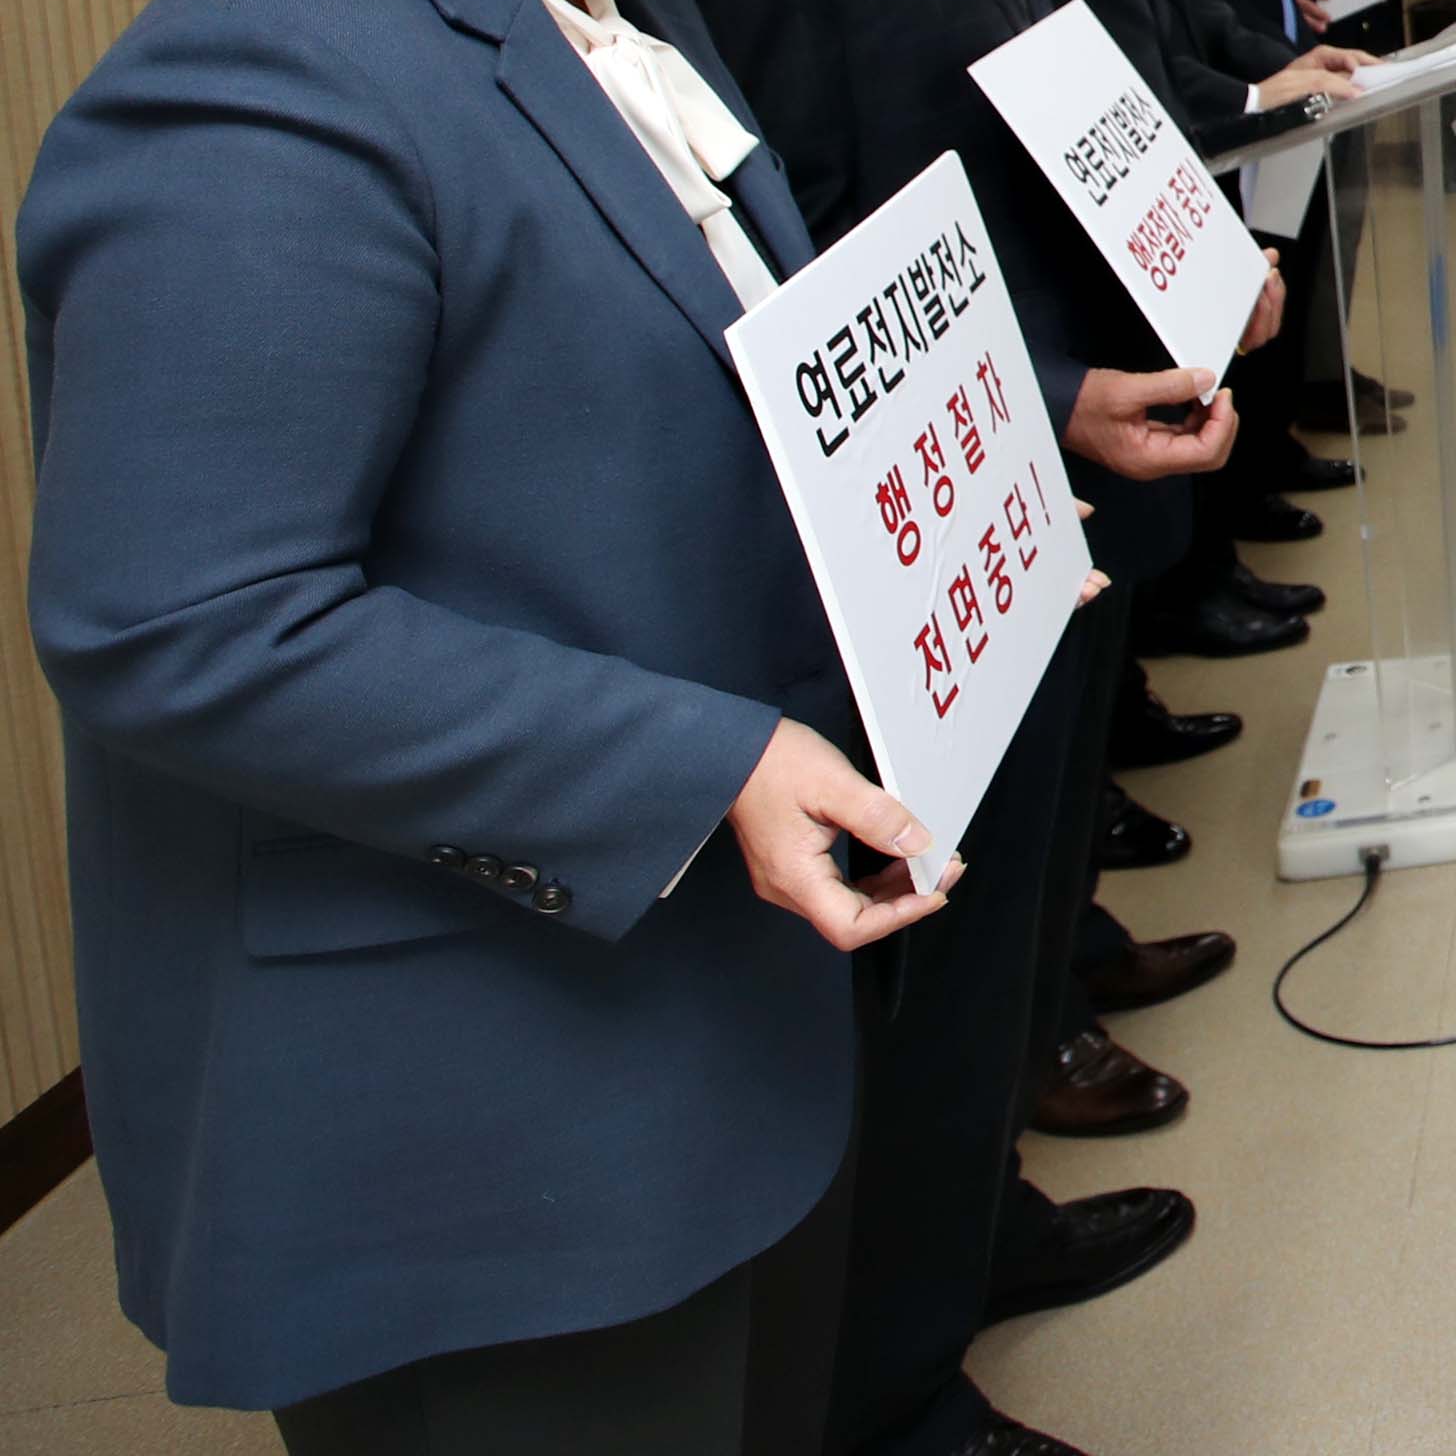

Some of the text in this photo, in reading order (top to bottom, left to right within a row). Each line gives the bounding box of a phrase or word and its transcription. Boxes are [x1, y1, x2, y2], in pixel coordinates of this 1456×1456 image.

[1064, 86, 1163, 207] 연료전지발전소
[1126, 157, 1214, 292] 행정절차 중단!
[796, 221, 986, 457] 연료전지발전소
